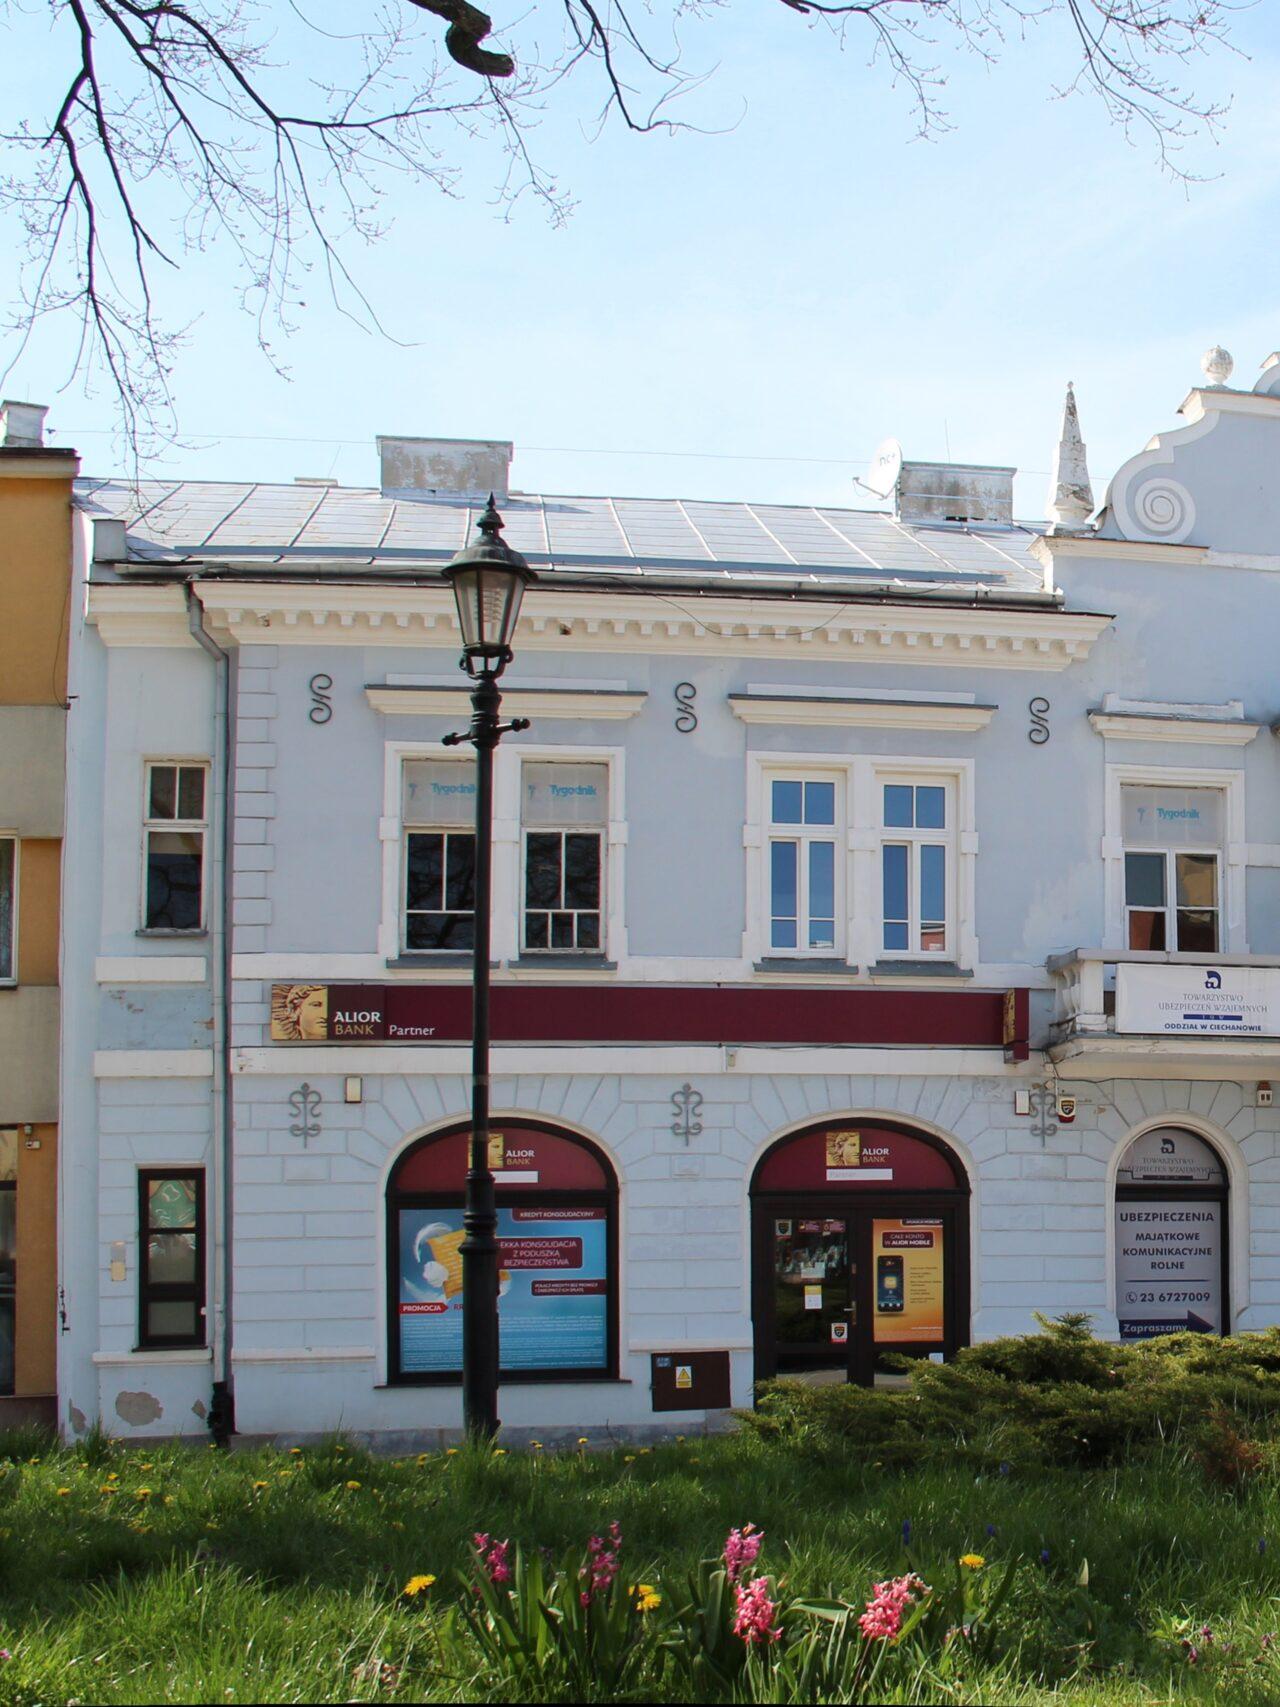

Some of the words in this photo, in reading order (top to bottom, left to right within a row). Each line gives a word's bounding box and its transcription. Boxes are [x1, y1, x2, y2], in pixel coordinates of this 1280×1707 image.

[550, 785, 597, 798] Tygodnik
[1156, 807, 1200, 820] Tygodnik
[1183, 993, 1244, 1002] TOWARZYSTWO
[1158, 1002, 1211, 1011] UBEZPIECZEŃ
[1213, 1004, 1268, 1013] WZAJEMNYCH
[334, 1011, 381, 1023] ALIOR
[335, 1024, 375, 1035] BANK
[389, 1024, 435, 1036] Partner
[1209, 1024, 1262, 1032] CIECHANOWIE
[862, 1155, 885, 1163] BANK
[1120, 1213, 1214, 1222] UBEZPIECZENIA
[1135, 1233, 1200, 1242] MAJĄTKOWE
[1122, 1248, 1213, 1256] KOMUNIKACYJNE
[1150, 1262, 1185, 1270] ROLNE
[1140, 1293, 1155, 1302] 23
[1158, 1293, 1211, 1302] 6727009
[1123, 1324, 1188, 1334] Zapraszamy
